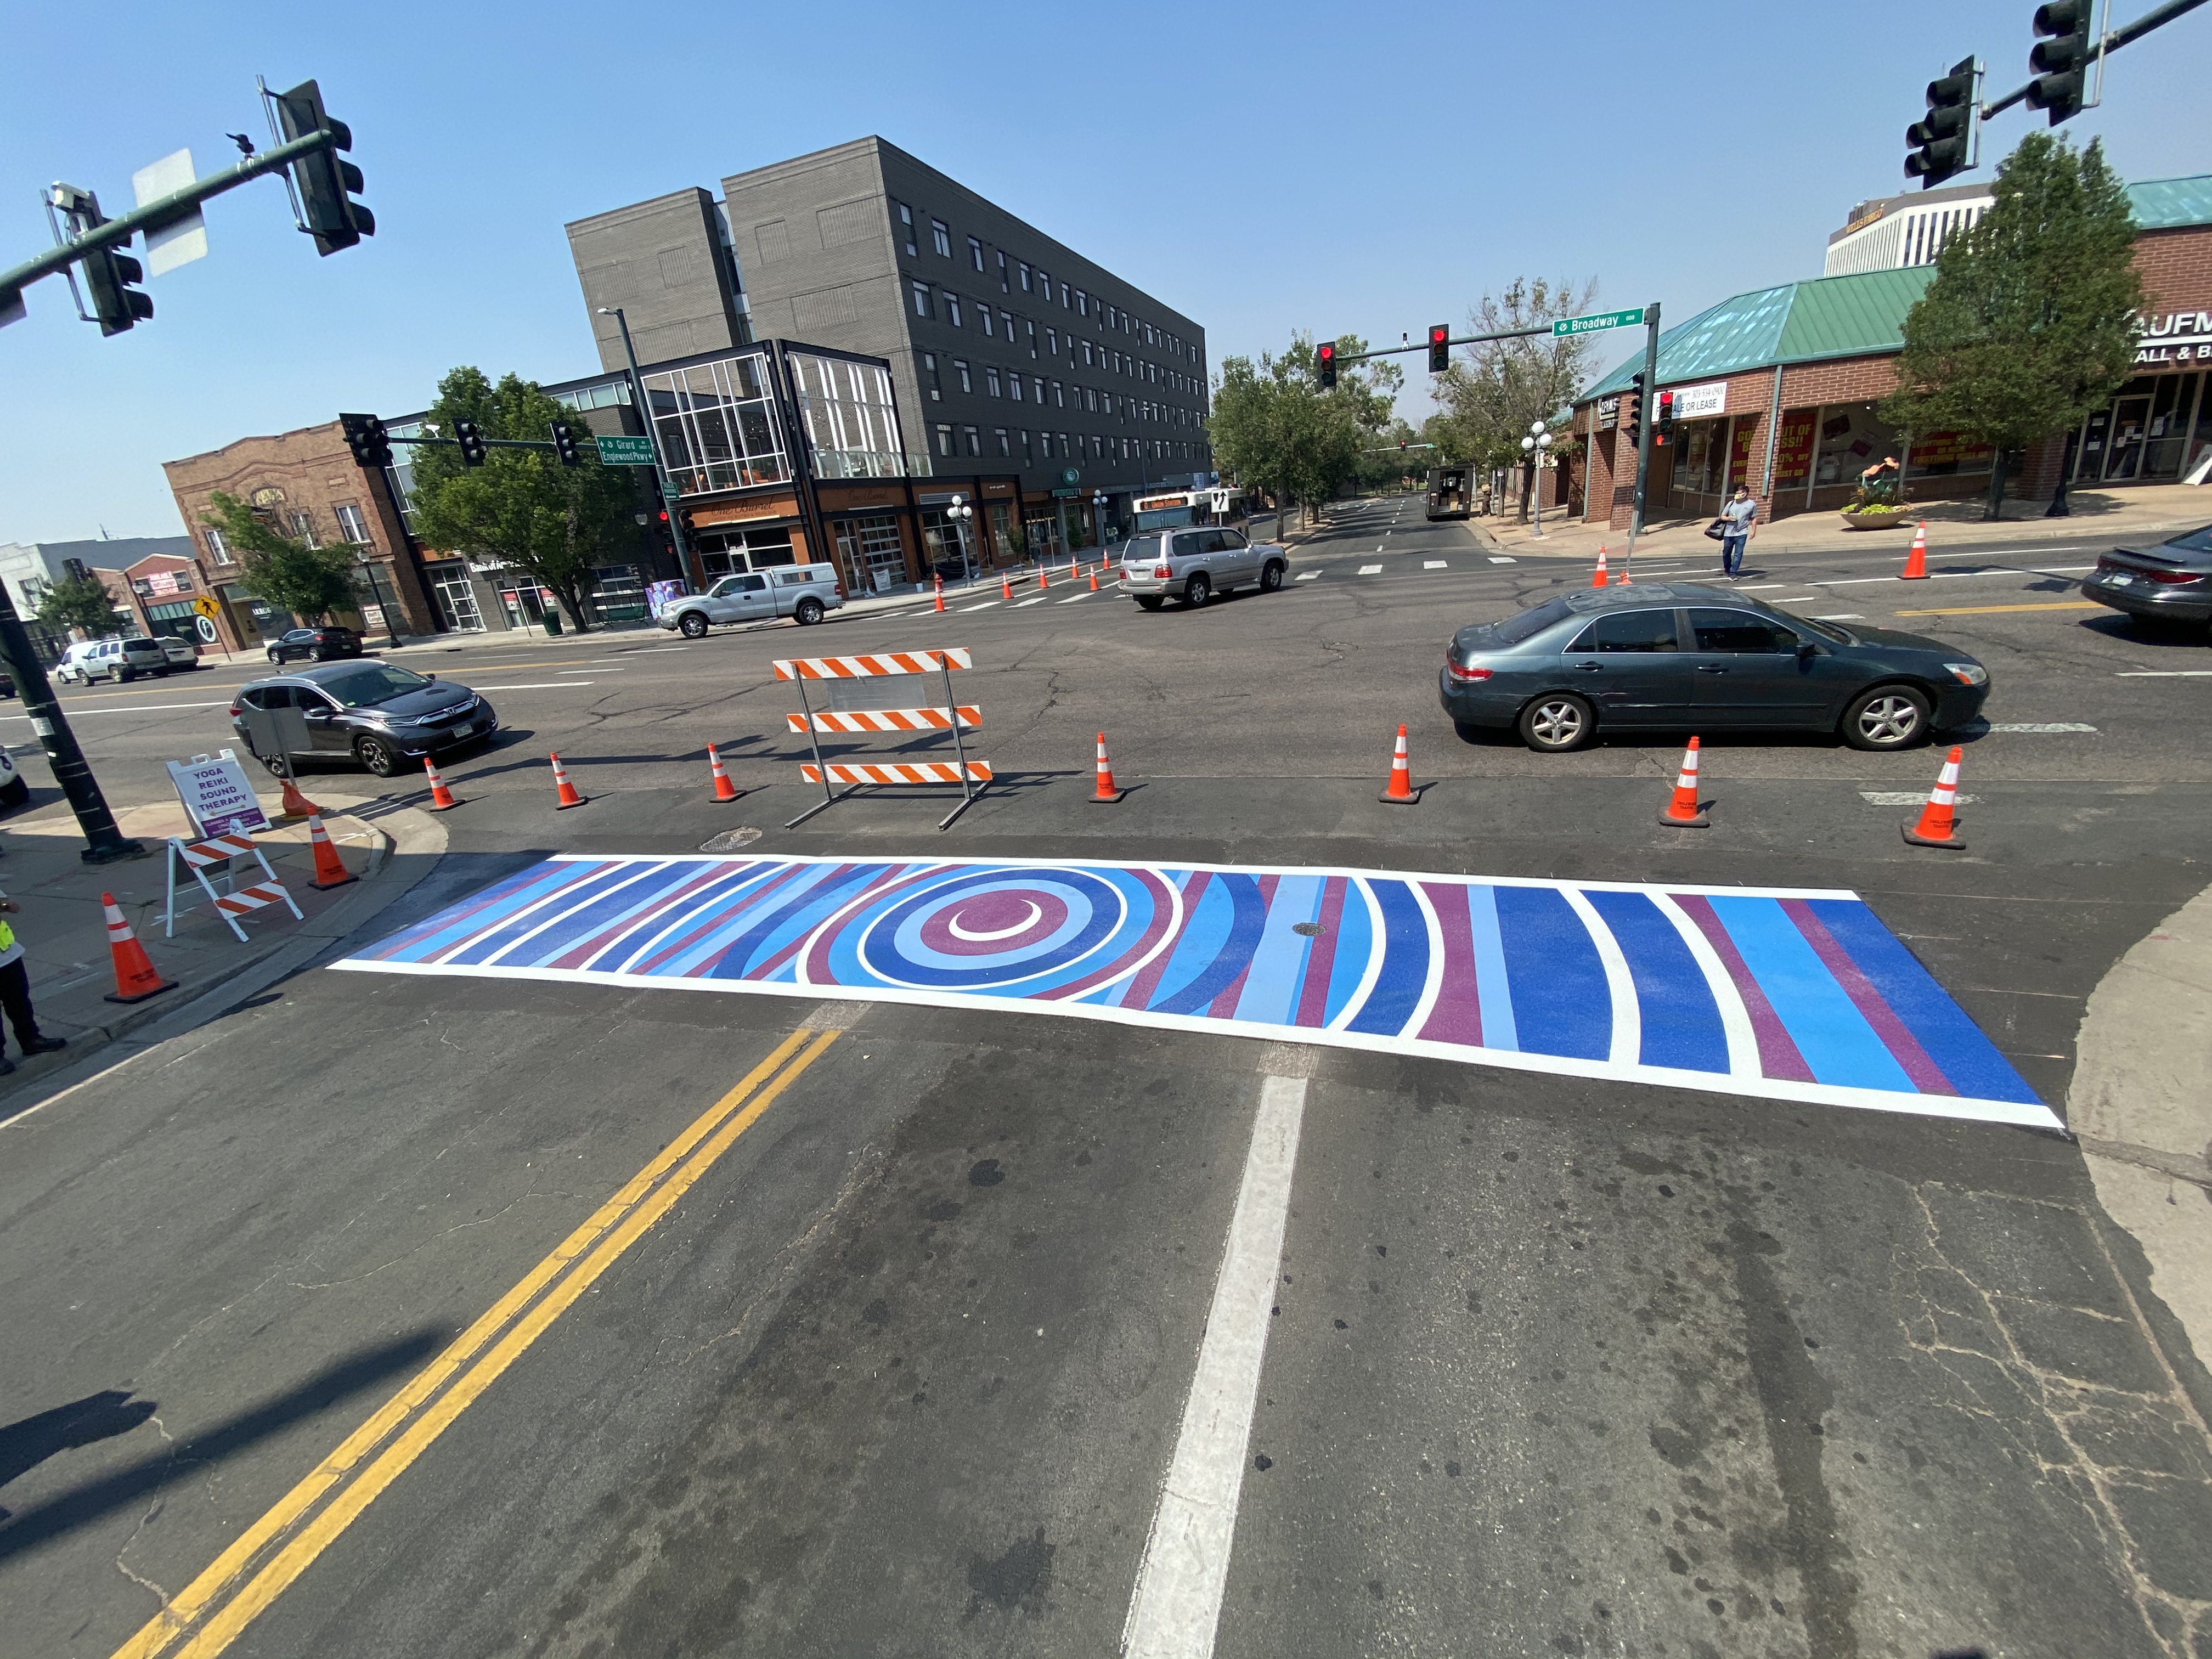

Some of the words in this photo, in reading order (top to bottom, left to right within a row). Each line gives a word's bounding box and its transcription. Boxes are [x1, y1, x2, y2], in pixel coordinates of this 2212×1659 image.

[1572, 315, 1619, 331] Broadway
[2131, 348, 2171, 363] ALL
[2176, 346, 2191, 360] &
[1673, 403, 1685, 413] ALE
[1686, 402, 1695, 411] OR
[1696, 398, 1717, 410] LEASE
[1797, 424, 1812, 436] OF
[616, 440, 635, 449] Girard
[602, 452, 633, 463] Englewood
[633, 452, 648, 462] Pkwy
[711, 504, 733, 516] One
[469, 561, 489, 573] Bank
[193, 768, 224, 780] YOGA
[198, 777, 229, 789] REIKI
[200, 786, 237, 800] SOUND
[199, 794, 247, 811] THERAPY
